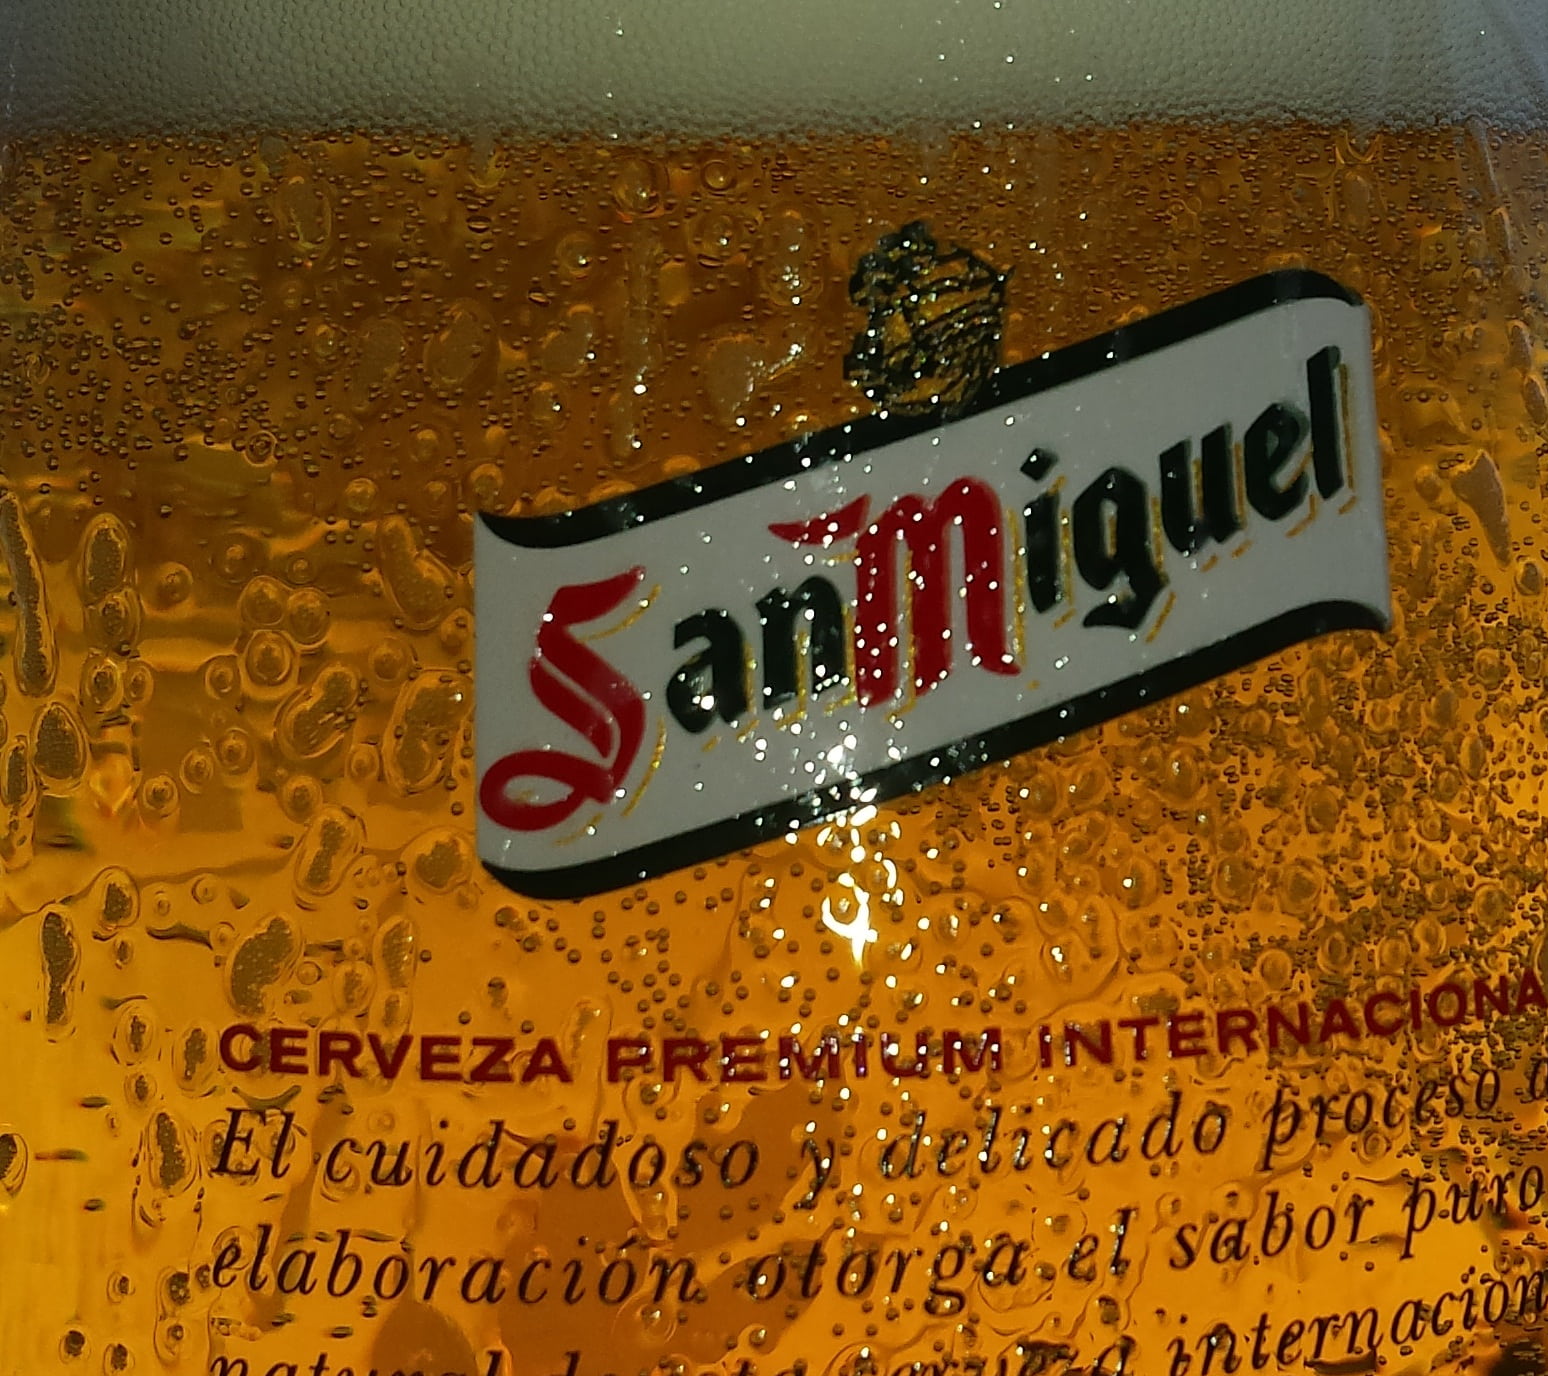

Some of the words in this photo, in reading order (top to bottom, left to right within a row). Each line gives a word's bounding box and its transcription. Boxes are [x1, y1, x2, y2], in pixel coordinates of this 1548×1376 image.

[219, 1024, 574, 1084] CERVEZA
[606, 1027, 1001, 1084] PREMIUM
[210, 1106, 294, 1180] El
[326, 1121, 760, 1191] cuidadoso
[793, 1137, 835, 1210] y
[880, 1090, 1227, 1180] delicado
[1260, 1069, 1501, 1171] proceso
[210, 1224, 699, 1306] elaboración
[746, 1232, 1030, 1317] otorga
[1064, 1206, 1140, 1283] el
[1168, 1190, 1375, 1271] sabor
[1400, 1164, 1545, 1260] puro
